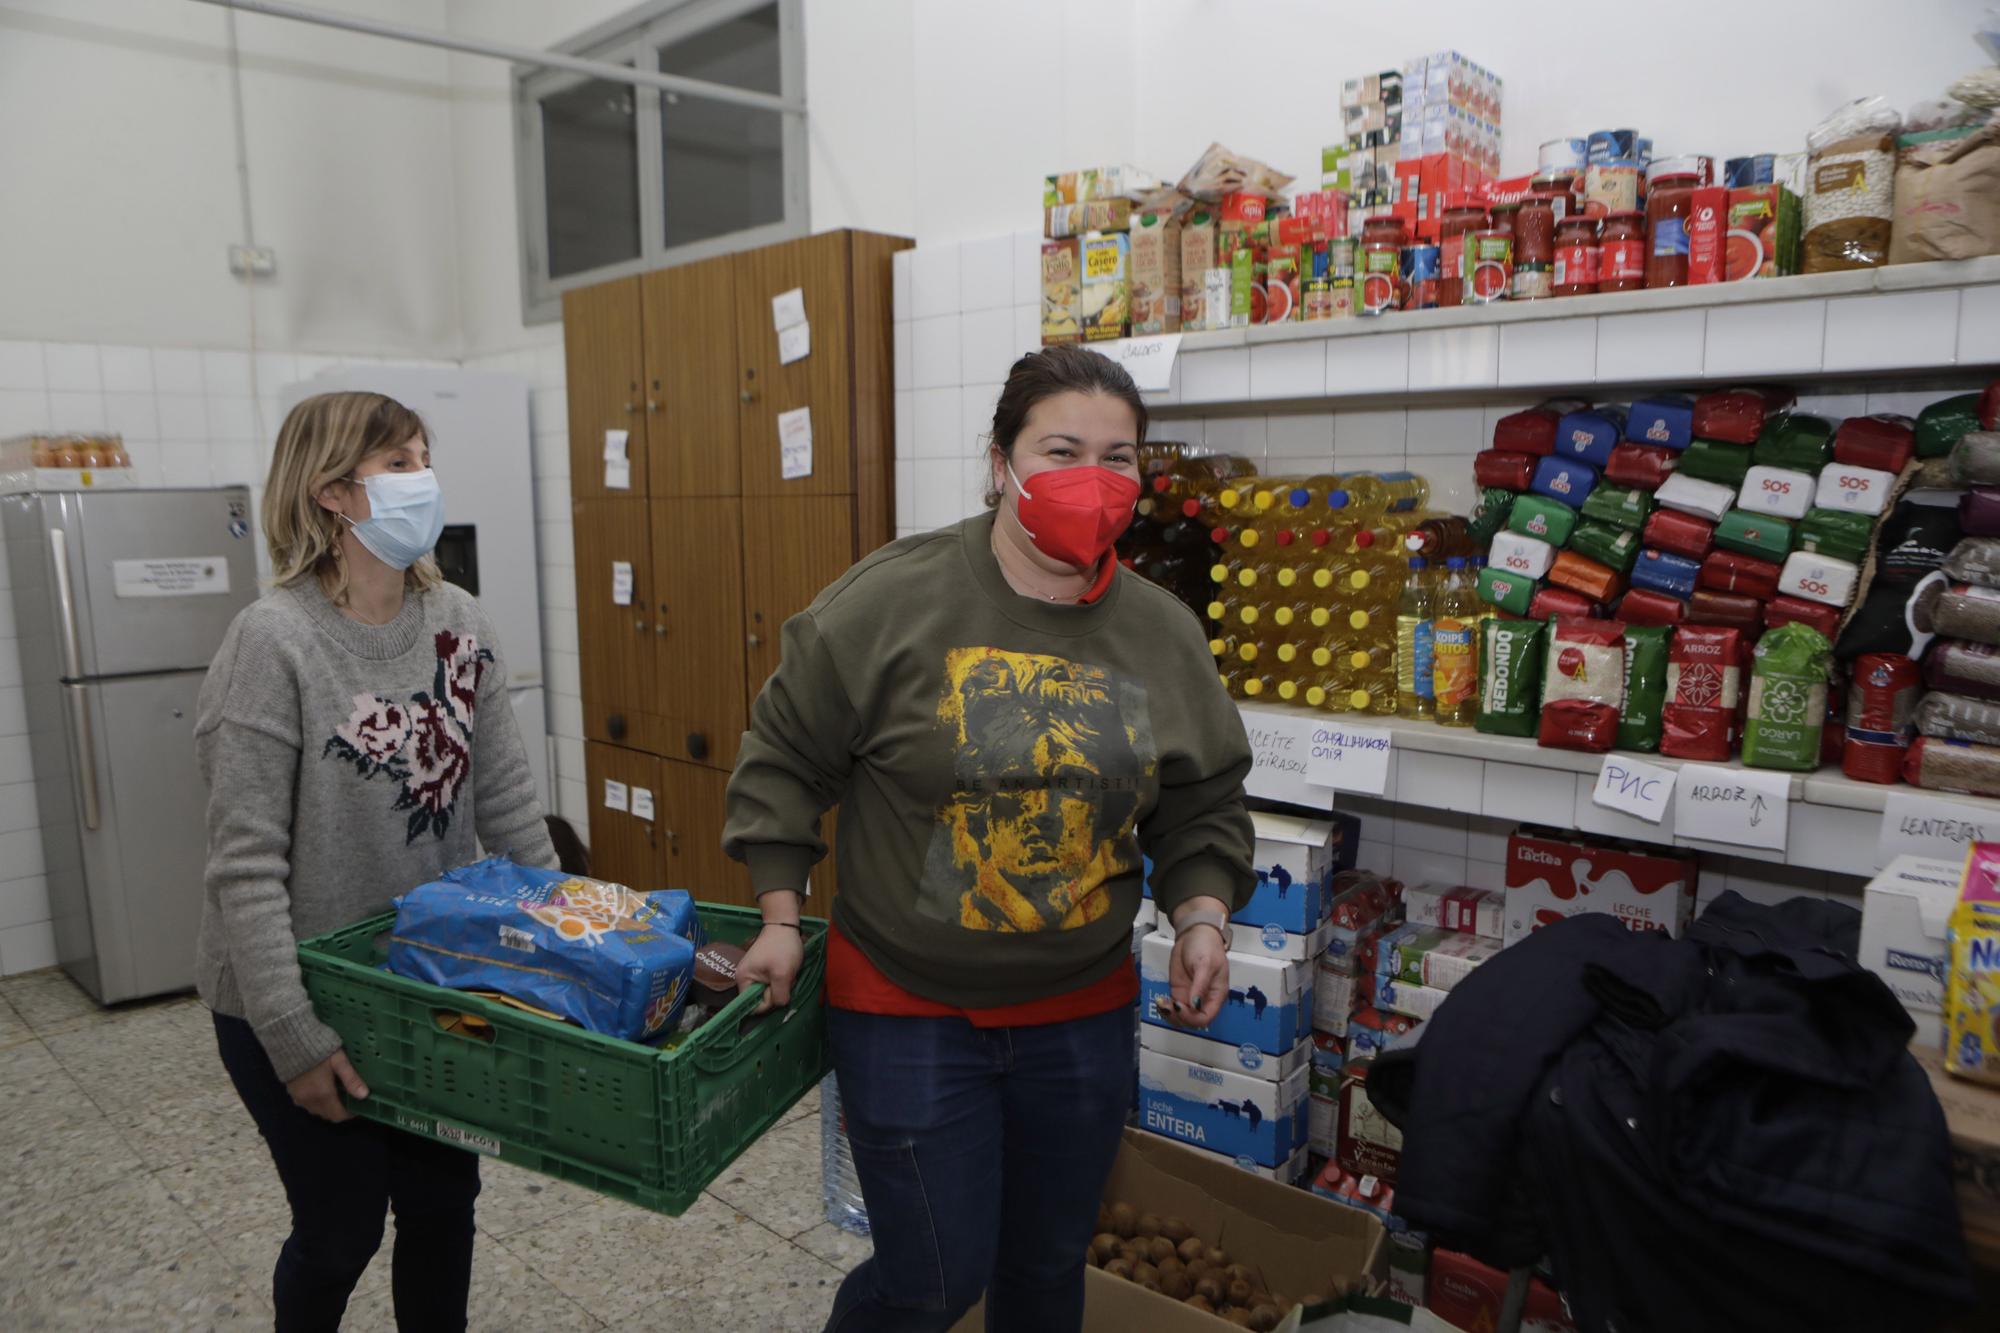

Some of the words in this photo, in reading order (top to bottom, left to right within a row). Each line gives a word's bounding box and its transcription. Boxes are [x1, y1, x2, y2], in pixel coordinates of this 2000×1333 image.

[1088, 256, 1118, 267] Casero
[1572, 430, 1594, 444] SOS
[1647, 429, 1670, 442] SOS
[1550, 480, 1571, 494] SOS
[1763, 478, 1791, 494] SOS
[1839, 475, 1870, 491] SOS
[1527, 521, 1548, 534] SOS
[1506, 556, 1530, 570] SOS
[1491, 580, 1512, 593] SOS
[1799, 578, 1829, 596] SOS
[1435, 631, 1465, 643] KOIPE
[1683, 643, 1721, 655] ARROZ
[1492, 630, 1514, 712] REDONDO
[1758, 727, 1801, 741] LARGO
[955, 779, 982, 792] BE
[1000, 778, 1026, 790] AN
[1606, 766, 1661, 801] РИС
[1900, 815, 1985, 844] LENTEJAS
[1612, 902, 1652, 919] LECHE
[1147, 1098, 1174, 1115] Leche
[1146, 1110, 1207, 1143] ENTERA
